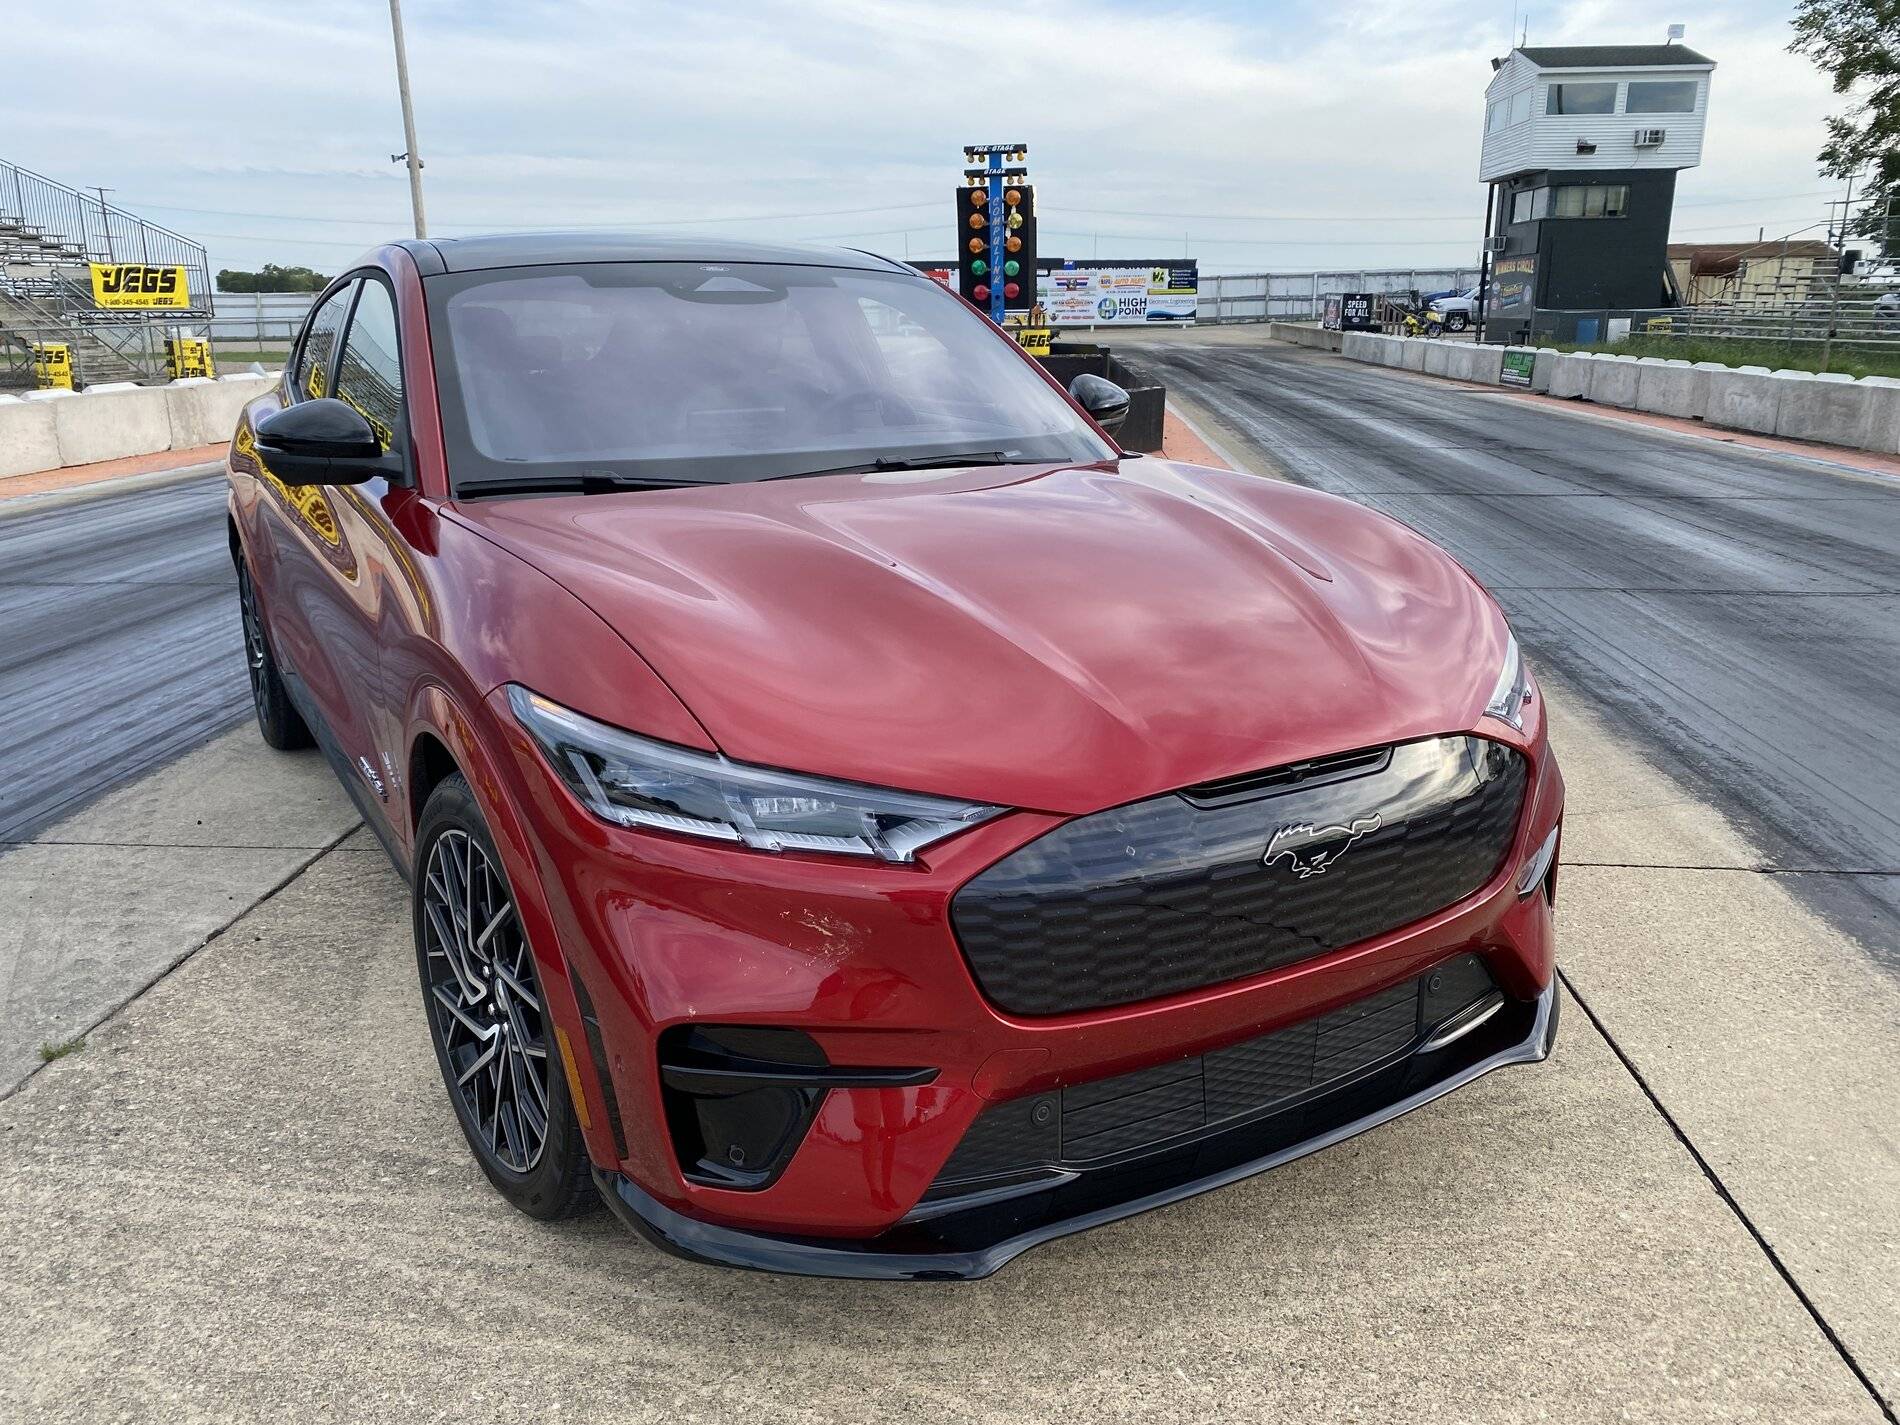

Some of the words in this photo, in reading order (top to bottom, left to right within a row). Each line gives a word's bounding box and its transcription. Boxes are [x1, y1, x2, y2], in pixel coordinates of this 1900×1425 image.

[973, 144, 1015, 152] PRE-STAGE
[992, 196, 1001, 284] COMPULINK
[102, 266, 177, 293] JEGS
[1119, 297, 1147, 307] HIGH
[1347, 300, 1367, 309] SPEED
[1118, 307, 1147, 316] POINT
[1344, 308, 1357, 317] FOR
[1357, 308, 1369, 317] ALL
[35, 349, 65, 364] EGS
